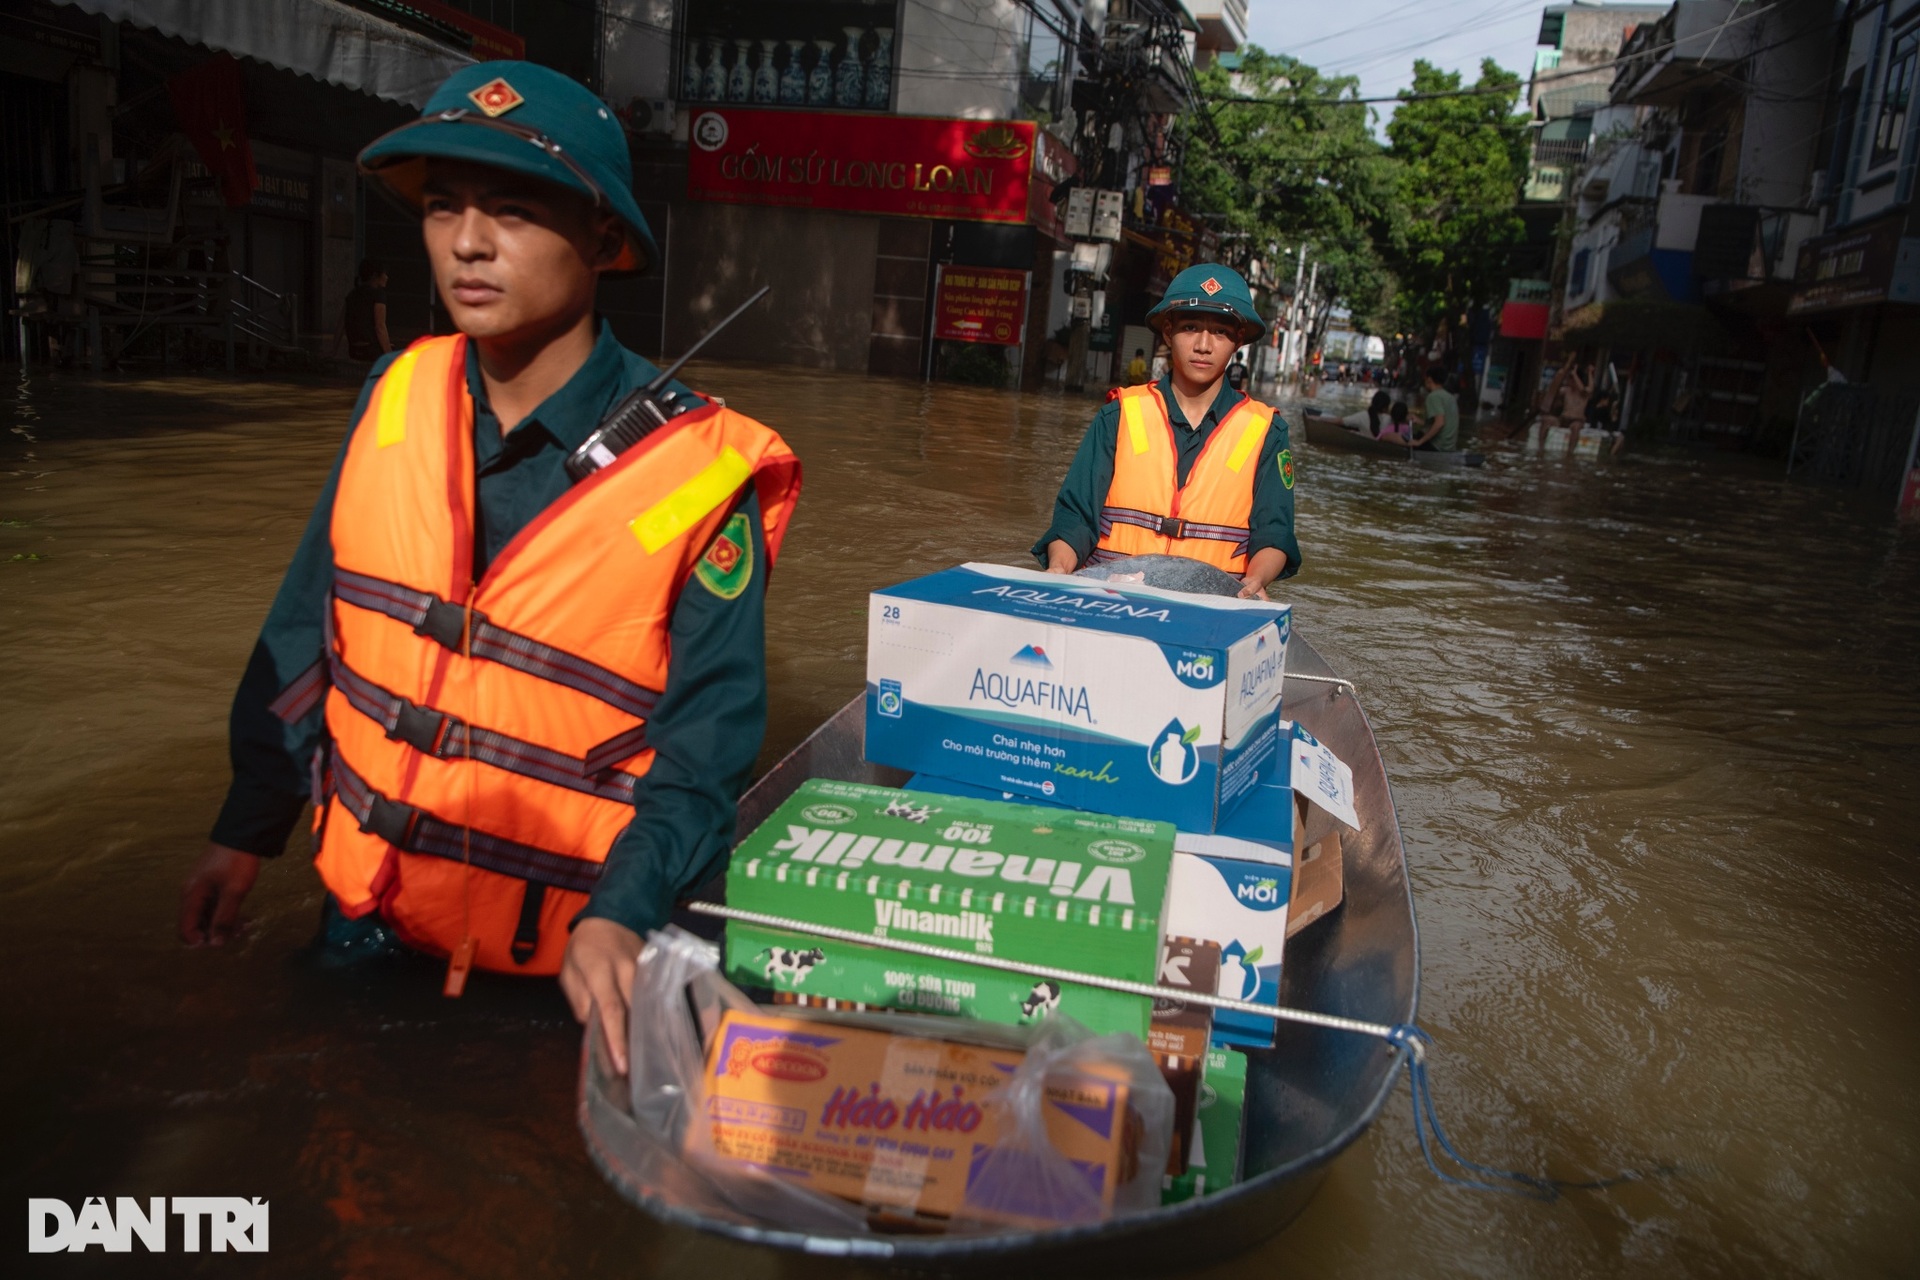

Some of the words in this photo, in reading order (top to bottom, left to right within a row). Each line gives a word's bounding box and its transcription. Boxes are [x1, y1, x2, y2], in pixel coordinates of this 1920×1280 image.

[720, 142, 782, 182] GỐM
[788, 149, 826, 185] SỨ
[830, 157, 906, 190] LONG
[912, 163, 995, 196] LOAN
[883, 605, 900, 619] 28
[972, 585, 1172, 623] AQUAFINA
[969, 667, 1092, 724] AQUAFINA
[1239, 650, 1276, 705] AQUAFINA
[942, 738, 963, 752] Cho
[964, 742, 984, 756] môi
[985, 746, 1020, 766] trường
[1021, 756, 1051, 770] thêm
[1053, 760, 1120, 784] xanh
[992, 733, 1018, 749] Chai
[1020, 739, 1042, 755] nhẹ
[1043, 745, 1066, 759] hơn
[773, 824, 1136, 905] Vinamilk
[875, 898, 993, 942] Vinamilk
[884, 970, 916, 989] 100%
[820, 1081, 899, 1130] Hảo
[903, 1084, 983, 1133] Hảo
